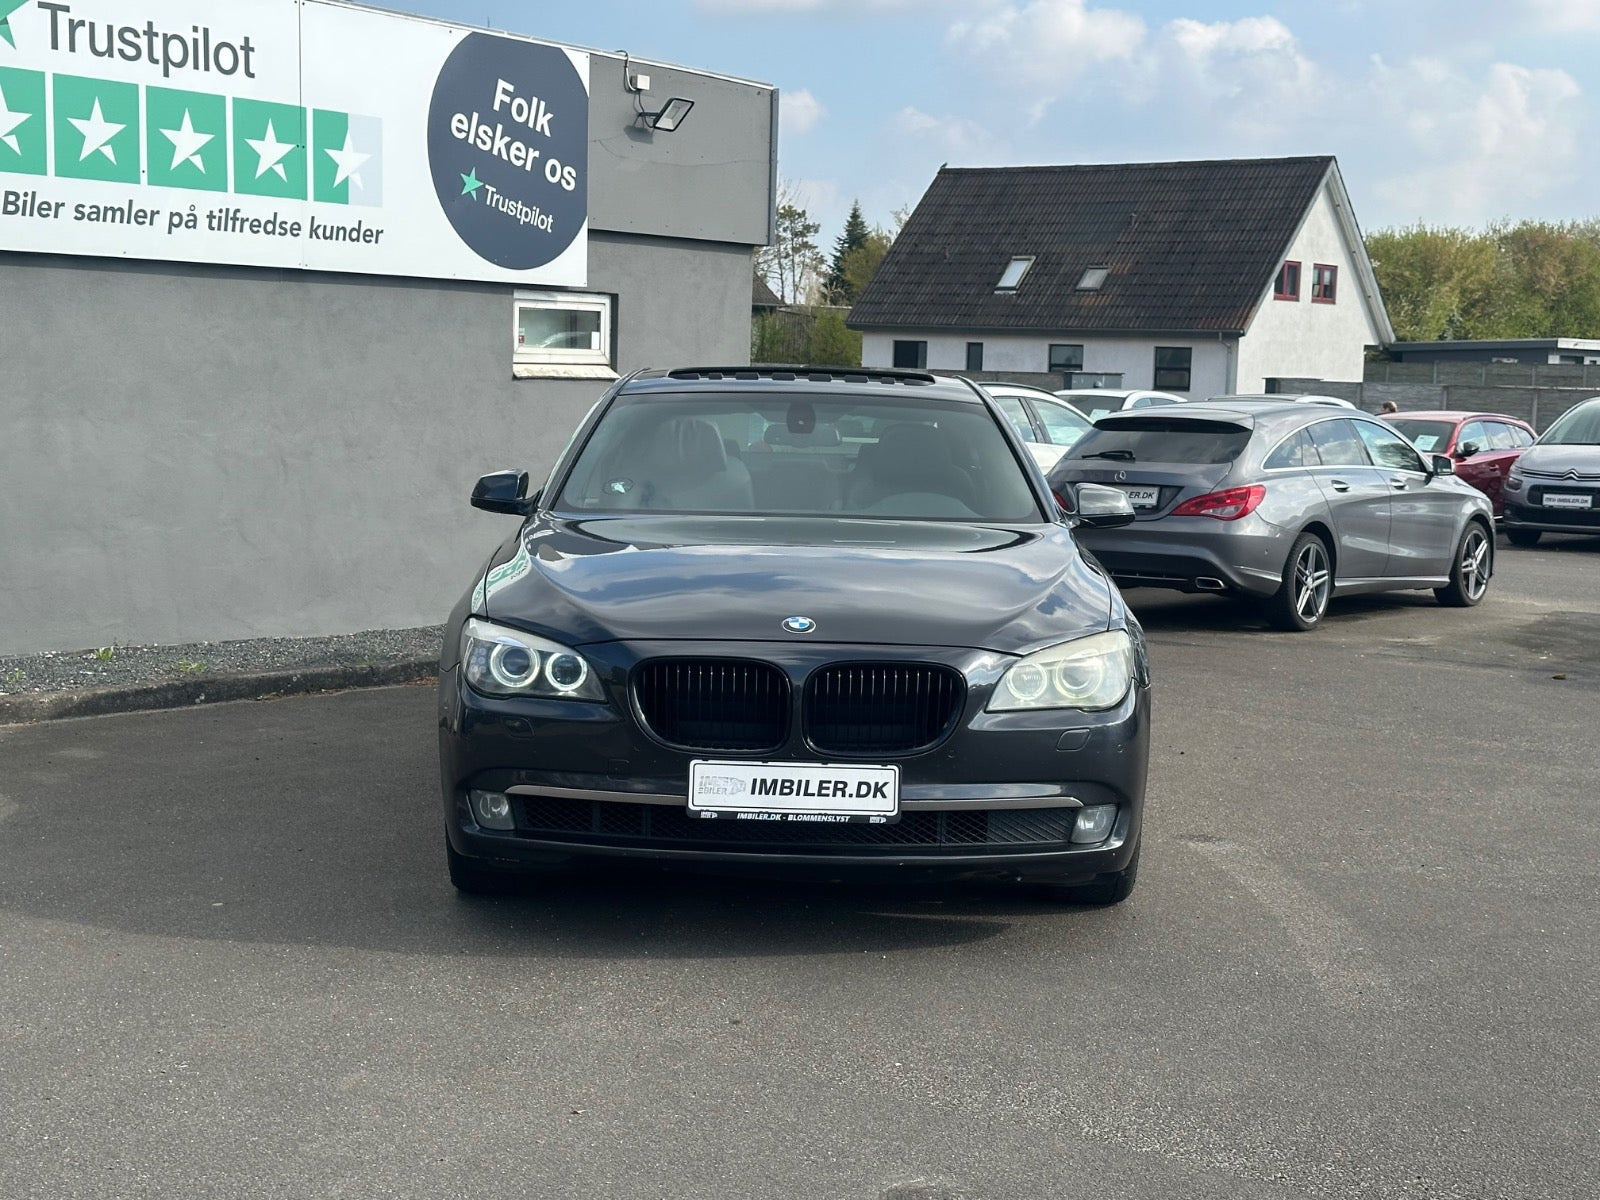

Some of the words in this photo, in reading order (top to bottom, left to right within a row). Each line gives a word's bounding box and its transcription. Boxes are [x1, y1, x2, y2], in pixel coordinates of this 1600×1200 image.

[38, 1, 257, 78] Trustpilot
[494, 79, 555, 137] Folk
[450, 110, 541, 174] elsker
[545, 158, 577, 191] os
[2, 191, 66, 219] Biler
[74, 200, 160, 226] samler
[168, 205, 198, 234] på
[206, 208, 302, 237] tilfredse
[309, 222, 384, 245] kunder
[485, 184, 554, 233] Trustpilot
[751, 778, 889, 799] IMBILER.DK
[737, 813, 782, 821] IMBILER.DK
[787, 814, 851, 823] BLOMMENSLYST
